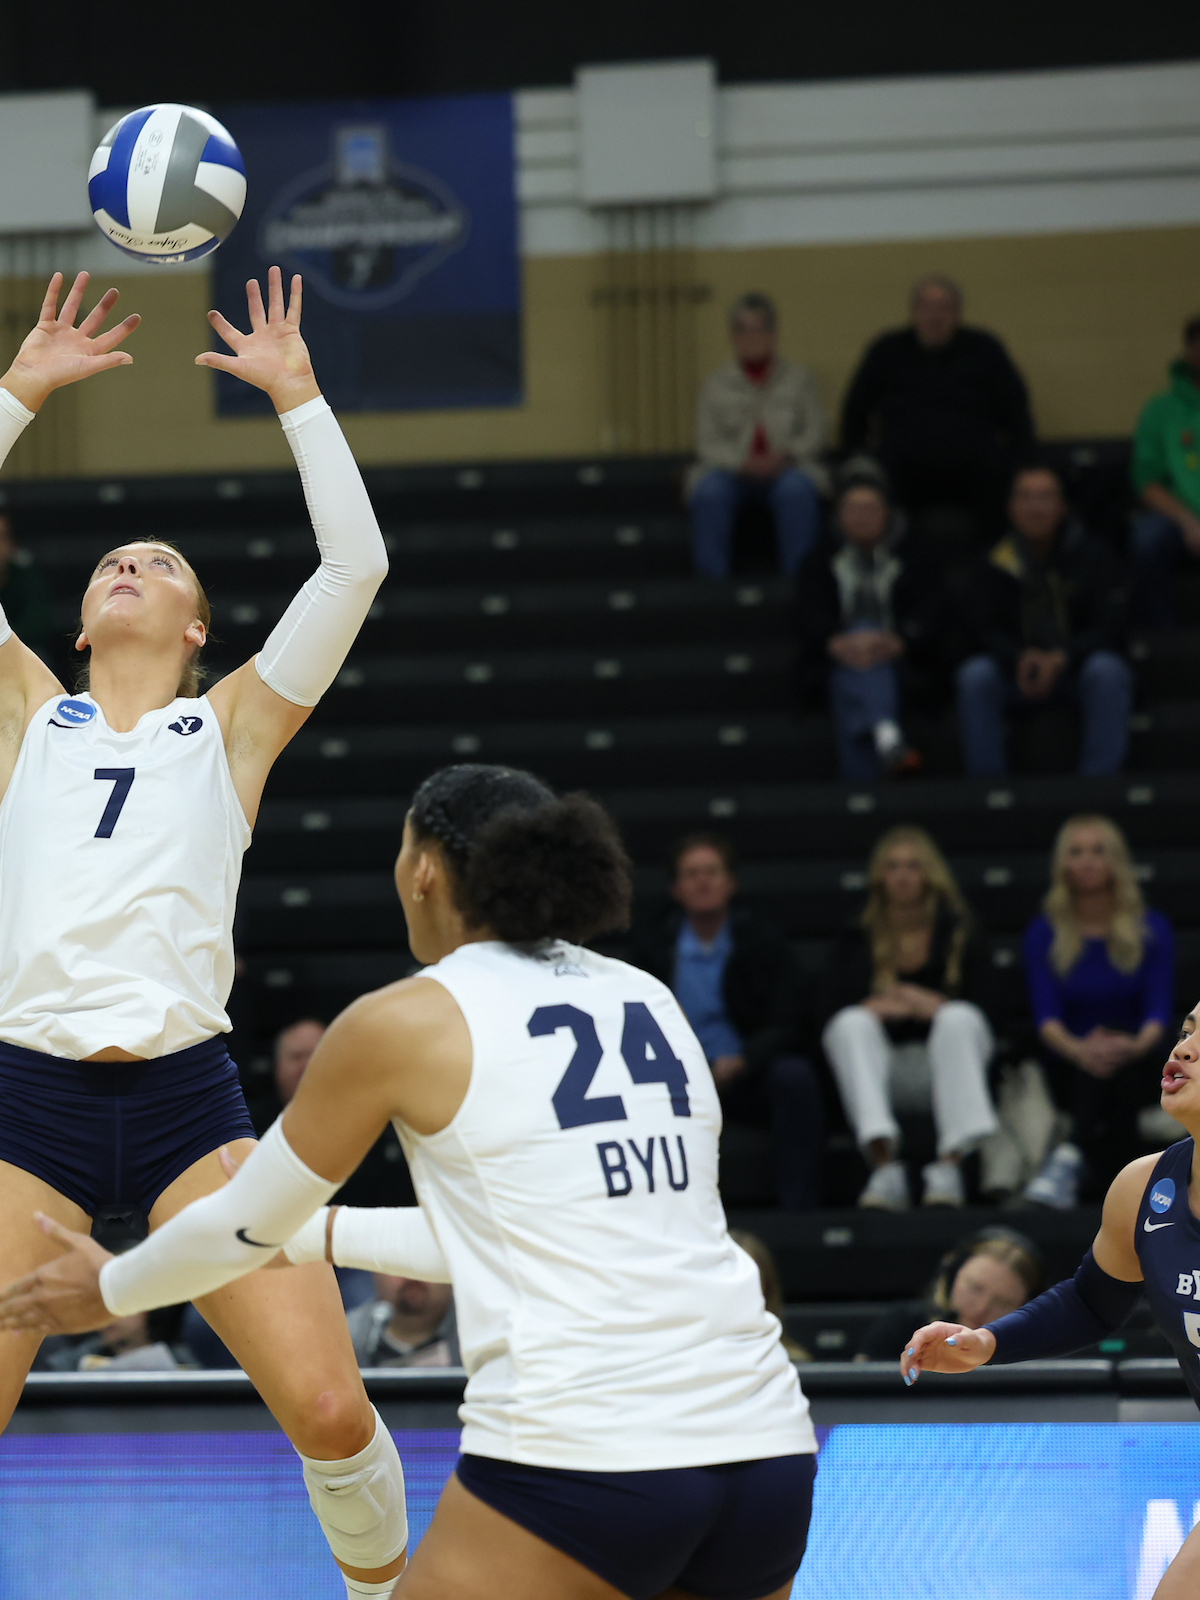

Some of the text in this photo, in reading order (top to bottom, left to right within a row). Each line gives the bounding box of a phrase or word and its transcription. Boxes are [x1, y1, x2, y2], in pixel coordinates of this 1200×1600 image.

[60, 705, 91, 720] NCAA
[94, 767, 136, 839] 7
[526, 1001, 692, 1131] 24
[596, 1135, 689, 1198] BYU
[1151, 1192, 1173, 1208] NCAA
